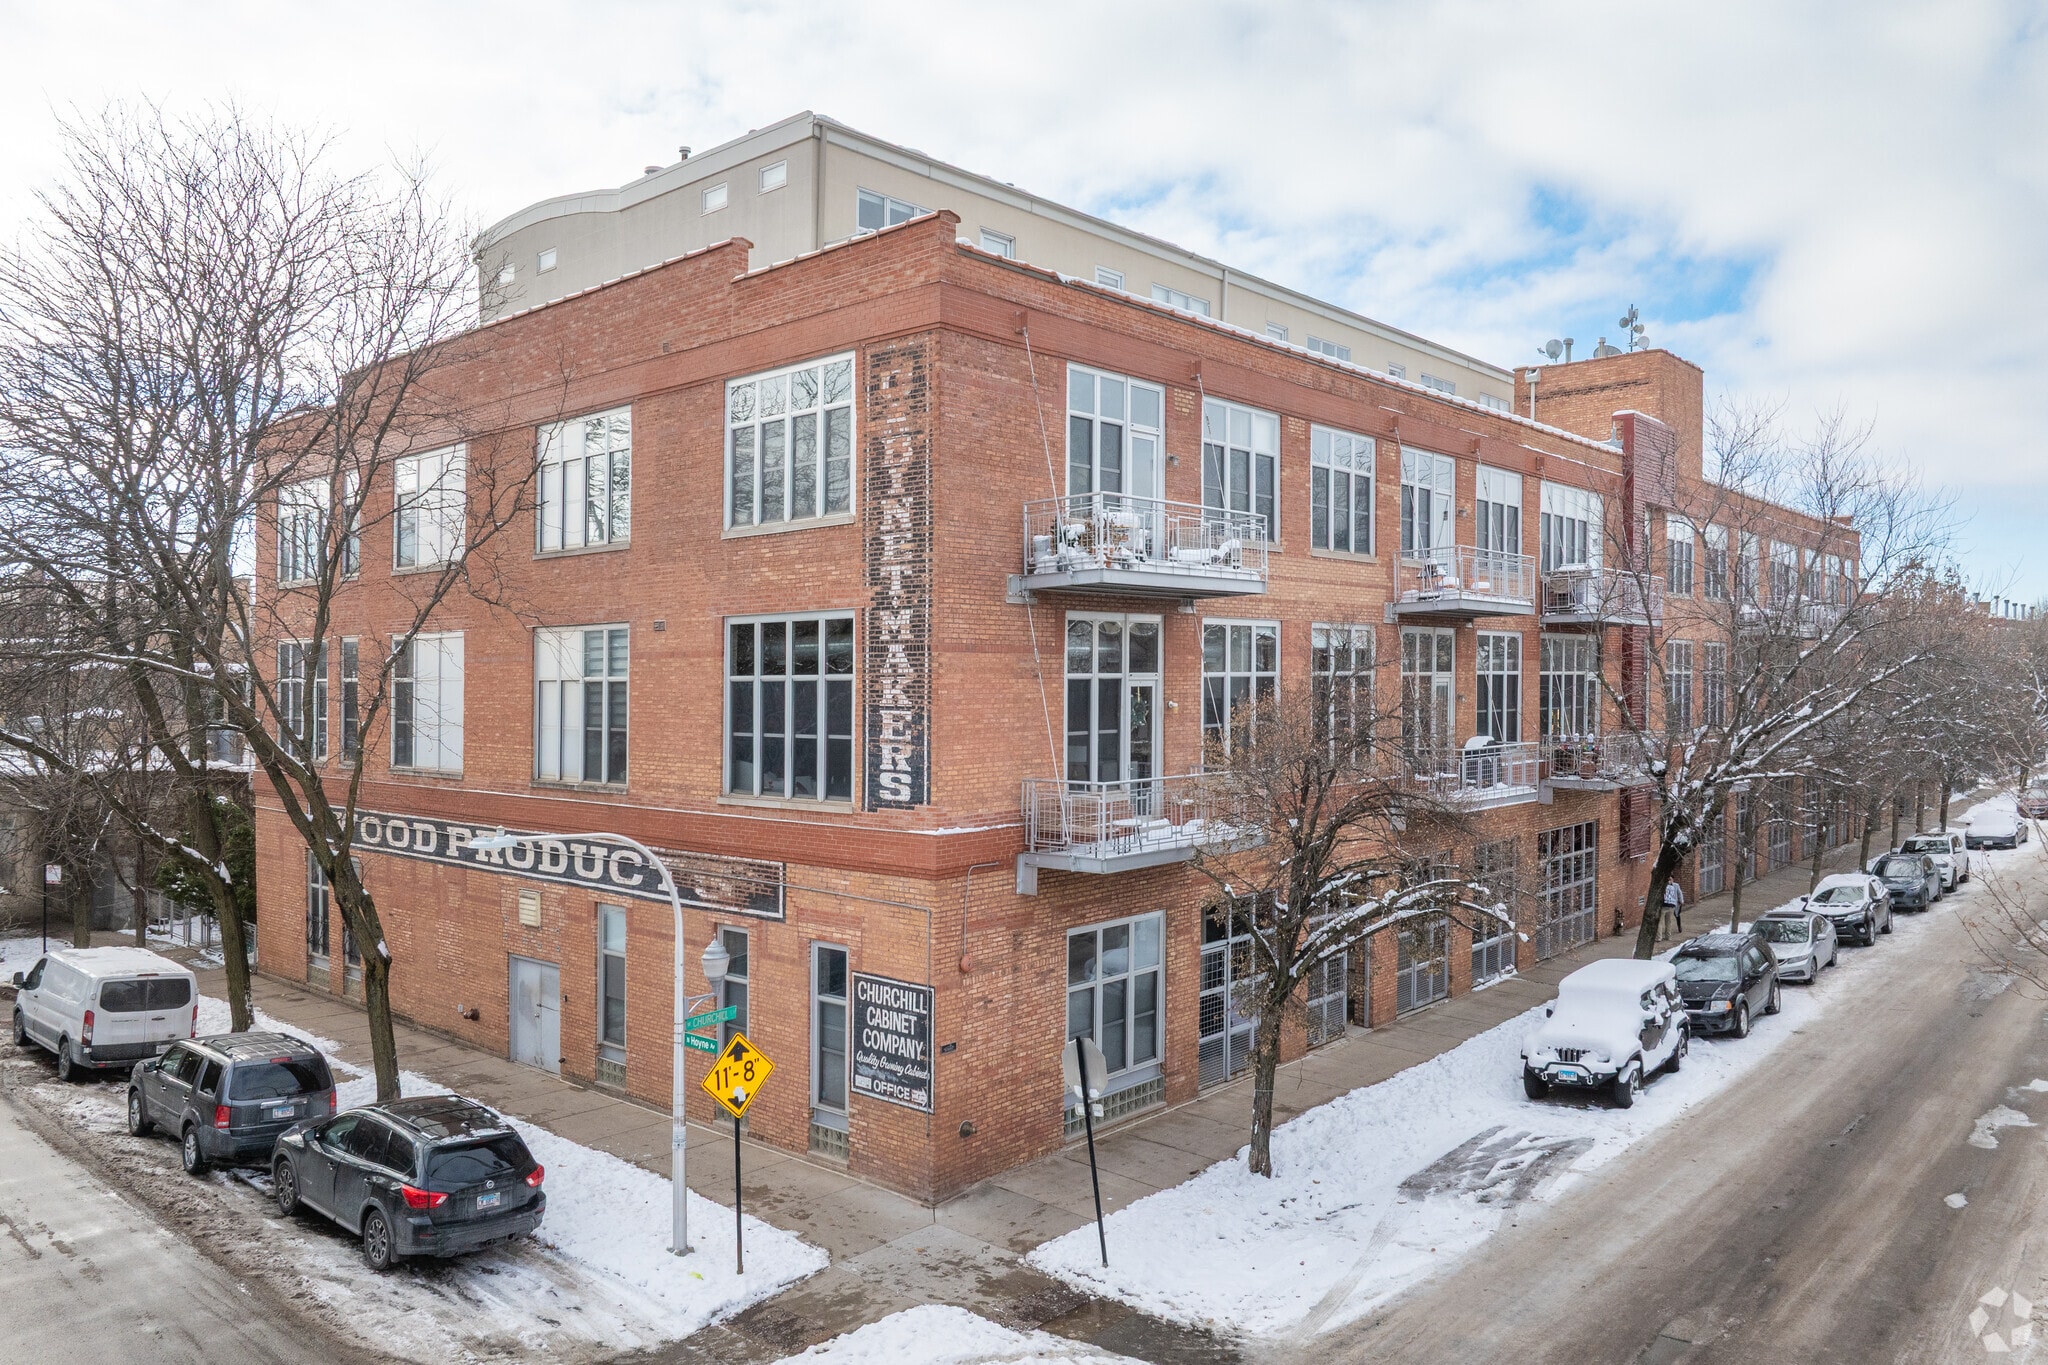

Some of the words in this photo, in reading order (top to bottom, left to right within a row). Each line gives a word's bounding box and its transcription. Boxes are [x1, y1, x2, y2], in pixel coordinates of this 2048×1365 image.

[879, 609, 912, 802] MAKERS
[857, 981, 927, 1014] CHURCHILL
[866, 1006, 917, 1035] CABINET
[690, 1036, 709, 1049] Hoyne
[863, 1028, 923, 1061] COMPANY
[856, 1050, 880, 1070] Quality
[873, 1080, 910, 1100] OFFICE
